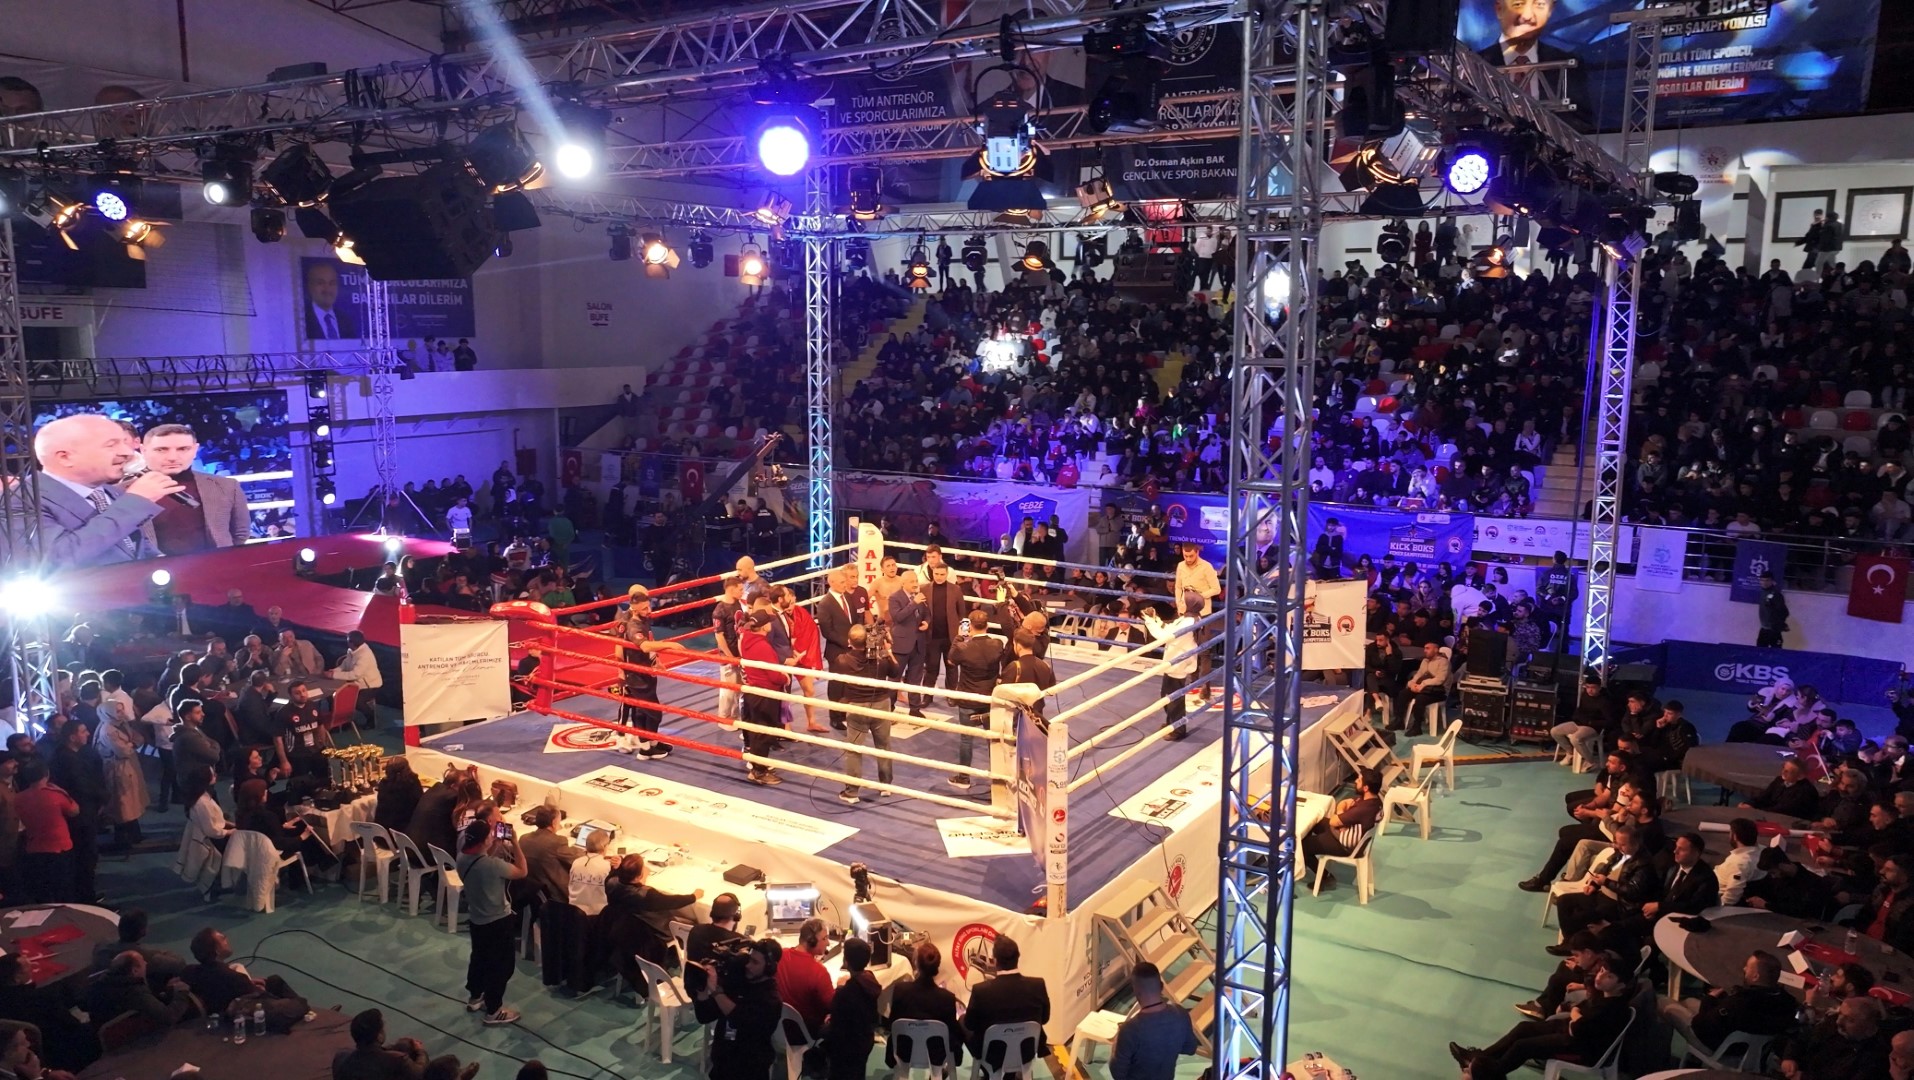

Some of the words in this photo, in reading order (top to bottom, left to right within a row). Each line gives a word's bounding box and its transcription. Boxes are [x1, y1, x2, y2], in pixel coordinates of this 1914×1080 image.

[851, 95, 875, 109] TÜM
[876, 90, 935, 107] ANTRENÖR
[840, 111, 853, 124] VE
[854, 105, 947, 123] SPORCULARIMIZA
[1134, 158, 1147, 167] Dr.
[1148, 157, 1178, 168] Osman
[1179, 156, 1205, 170] Aşkın
[1206, 154, 1225, 165] BAK
[1122, 168, 1161, 182] GENÇLİK
[1161, 169, 1175, 180] VE
[1175, 167, 1200, 180] SPOR
[1201, 164, 1239, 178] BAKANI
[419, 291, 464, 305] DİLERİM
[19, 306, 64, 320] BÜFE
[586, 302, 613, 311] SALON
[590, 312, 609, 321] BÜFE
[1018, 501, 1045, 511] GEBZE
[1412, 543, 1435, 554] BOKS
[418, 661, 449, 670] ANTRENÖR
